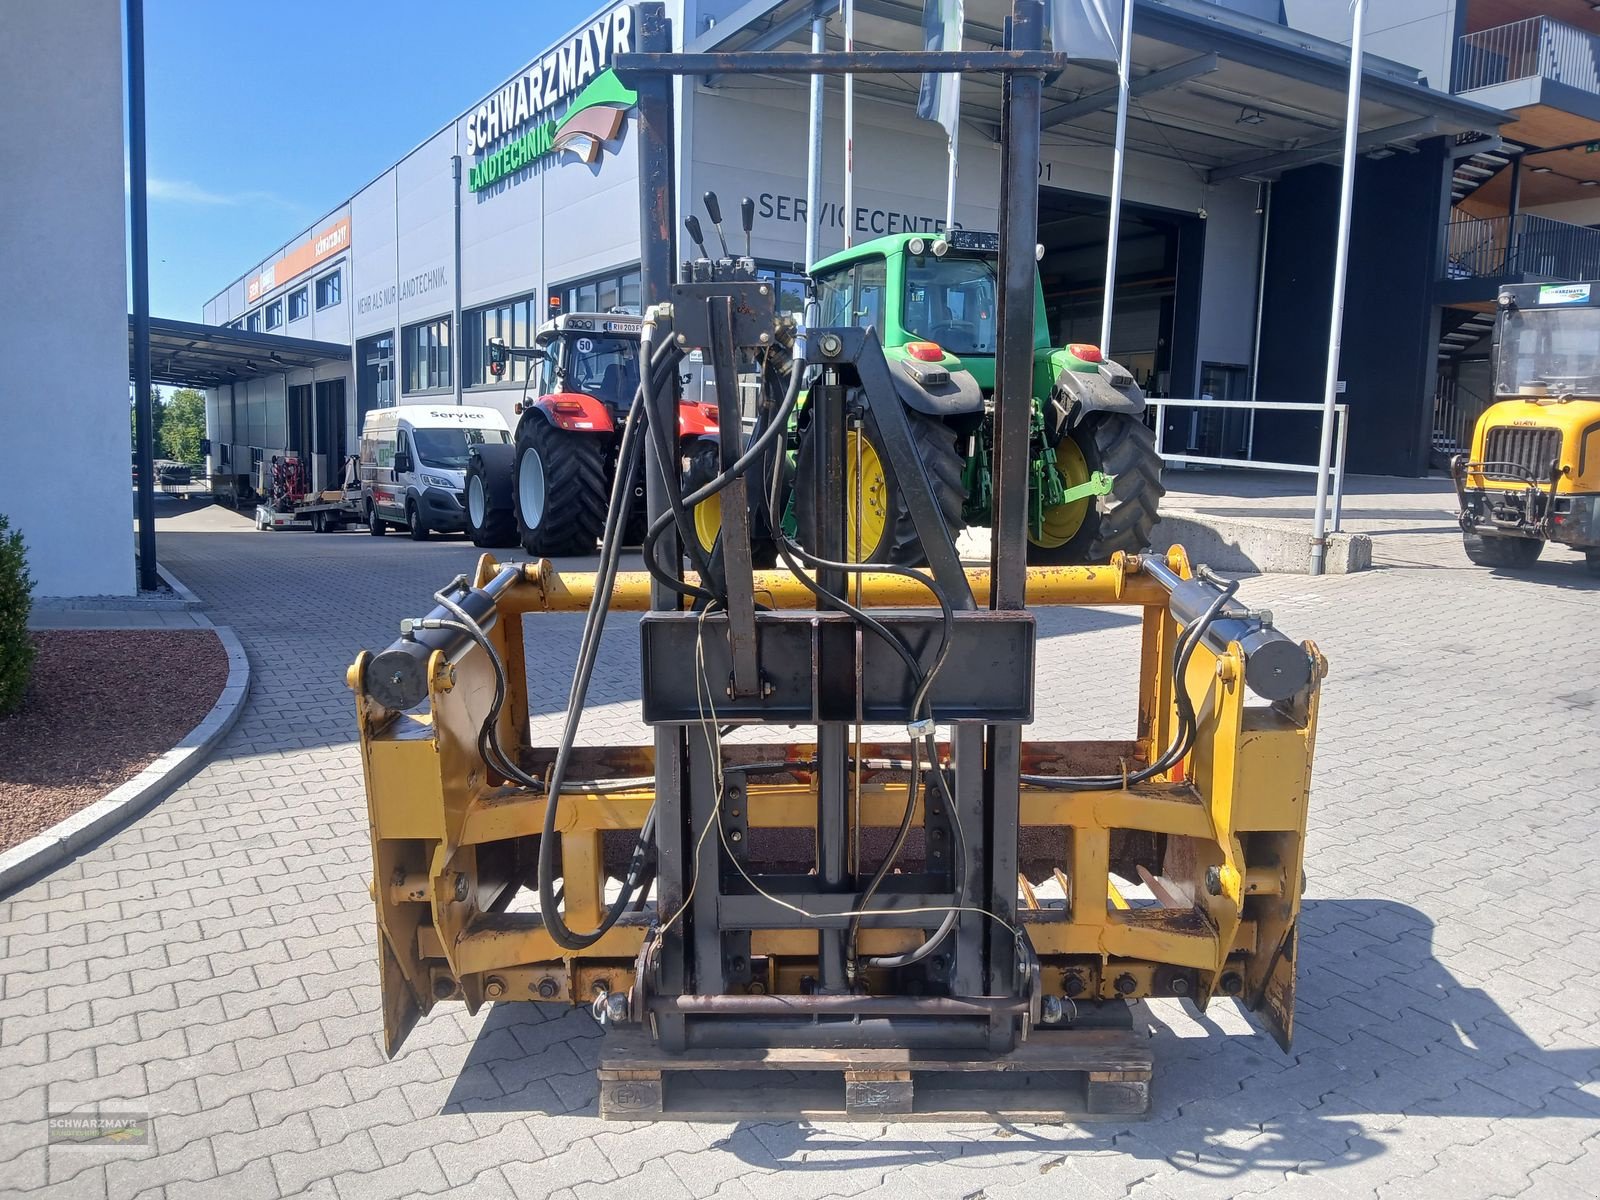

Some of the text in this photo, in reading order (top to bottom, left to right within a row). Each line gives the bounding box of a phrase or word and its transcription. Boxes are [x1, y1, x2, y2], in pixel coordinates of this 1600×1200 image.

[466, 4, 632, 156] SCHWARZMAYR
[468, 121, 554, 193] LANDTECHNIK
[1038, 160, 1051, 181] 1
[758, 193, 963, 236] SERVIECENTE
[357, 294, 372, 315] MEHR
[372, 290, 383, 311] ALS
[383, 285, 396, 306] NUR
[579, 340, 592, 351] 50
[430, 411, 485, 423] Service
